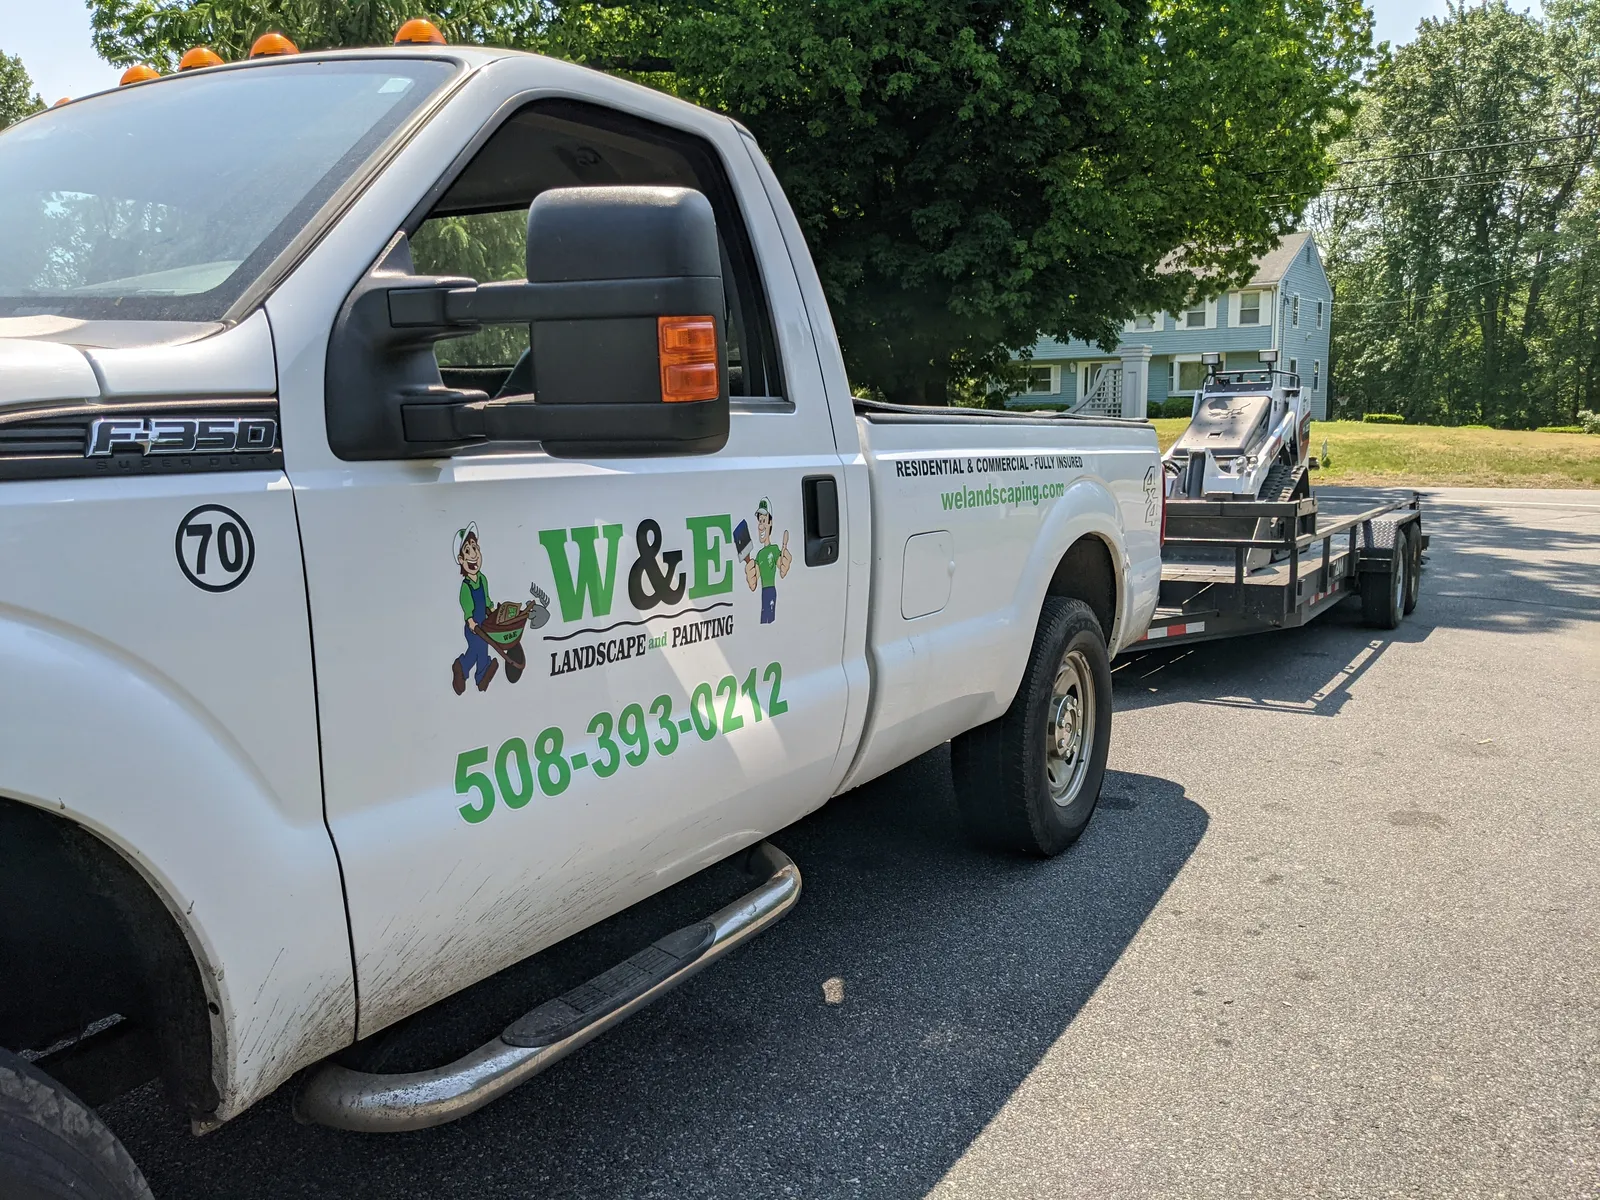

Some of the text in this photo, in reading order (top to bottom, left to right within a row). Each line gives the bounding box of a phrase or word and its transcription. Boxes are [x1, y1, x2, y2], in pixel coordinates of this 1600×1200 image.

[85, 418, 277, 458] F-350
[96, 456, 274, 470] SUPER DUTY
[896, 459, 965, 477] RESIDENTIAL
[967, 459, 974, 472] &
[976, 457, 1029, 472] COMMERCIAL
[1034, 457, 1055, 470] FULLY
[1057, 456, 1083, 469] INSURED
[941, 481, 1065, 511] welandscaping.com
[186, 521, 244, 575] 70
[550, 615, 734, 677] LANDSCAPE and PAINTING
[455, 661, 789, 824] 508-393-0212
